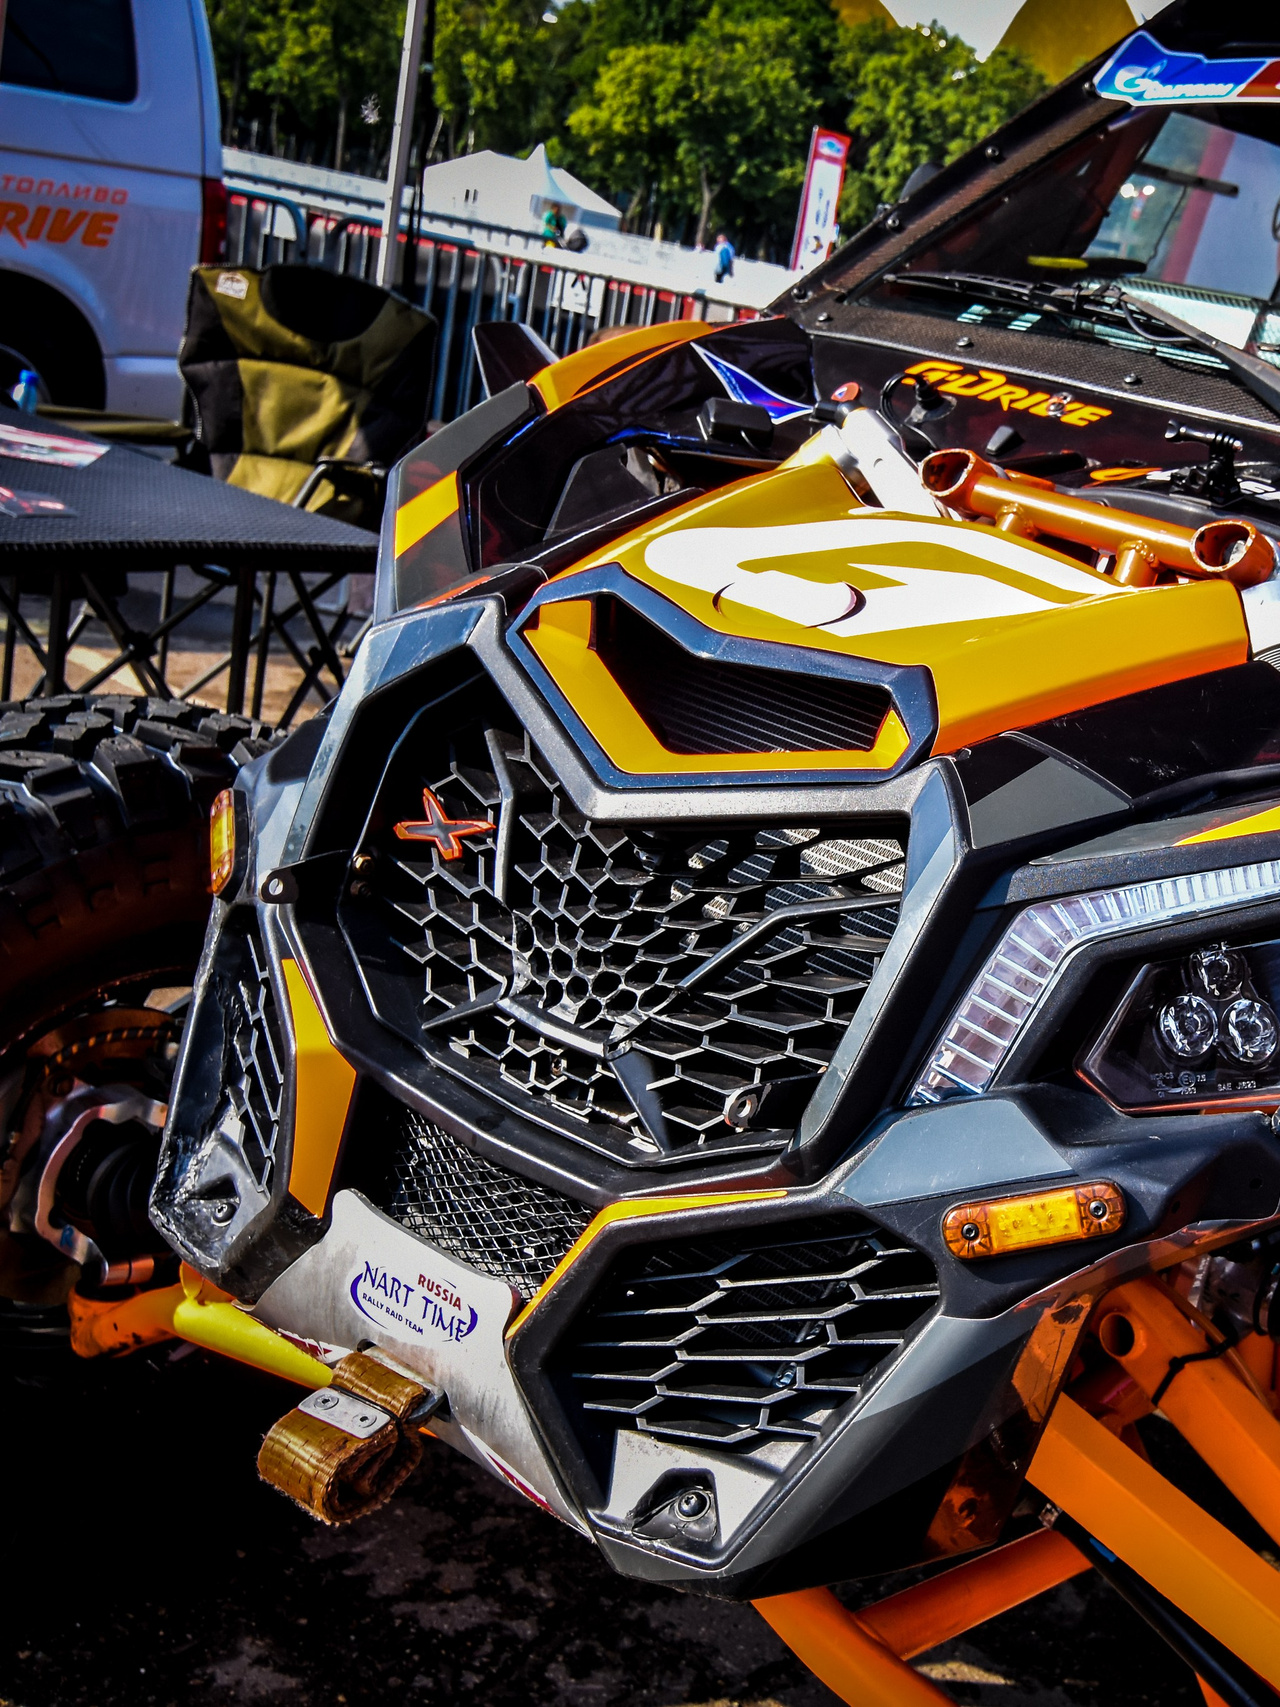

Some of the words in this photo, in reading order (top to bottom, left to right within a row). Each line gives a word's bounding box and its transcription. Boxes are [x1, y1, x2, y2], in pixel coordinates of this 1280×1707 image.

[2, 173, 129, 205] ТОПЛИВО
[363, 1260, 415, 1308] NART
[421, 1296, 467, 1342] TIME
[417, 1273, 461, 1312] RUSSIA
[362, 1292, 384, 1310] RALLY
[385, 1306, 403, 1322] RAID
[405, 1318, 424, 1336] TEAM
